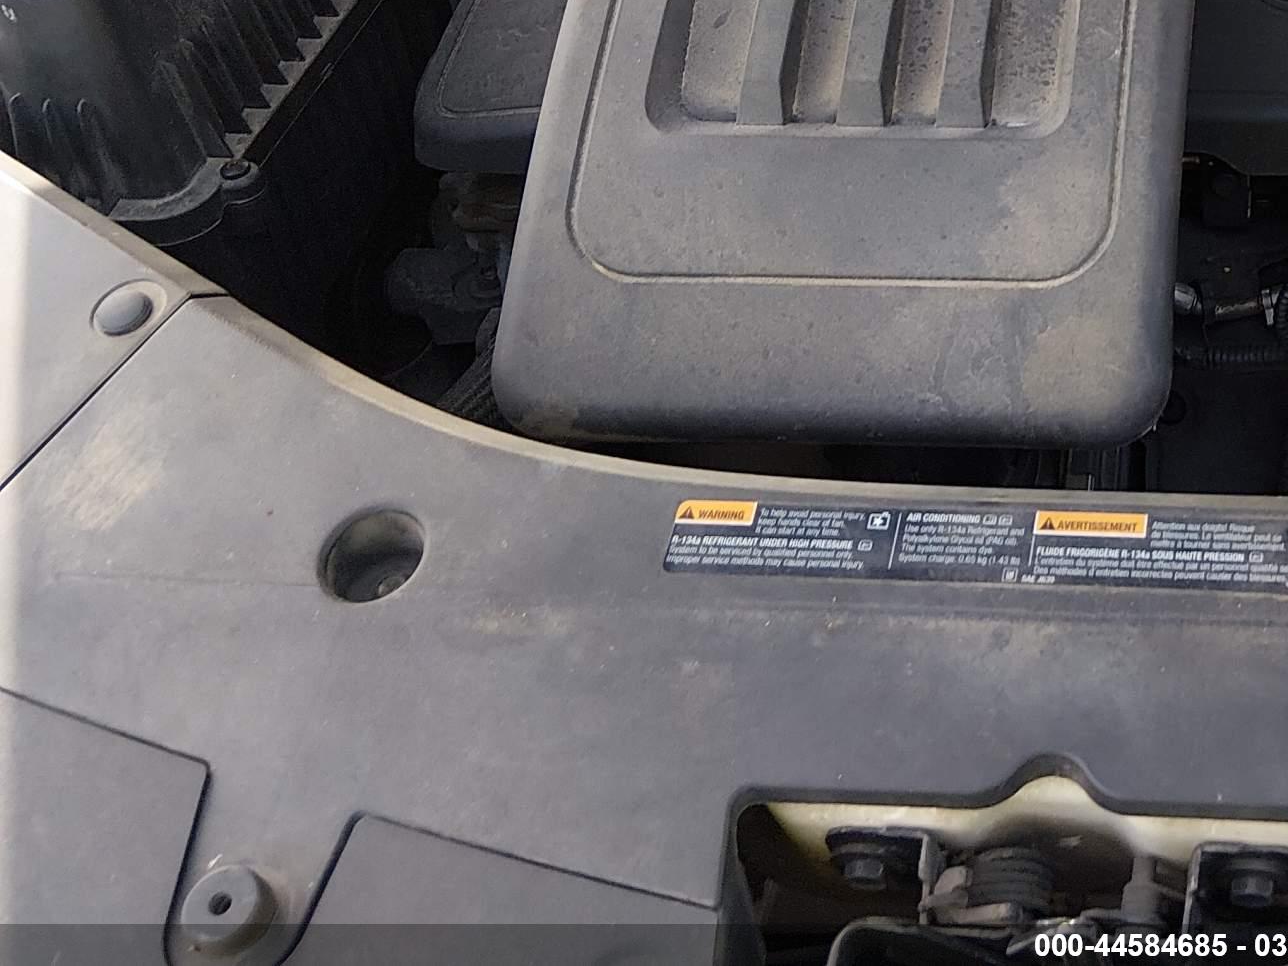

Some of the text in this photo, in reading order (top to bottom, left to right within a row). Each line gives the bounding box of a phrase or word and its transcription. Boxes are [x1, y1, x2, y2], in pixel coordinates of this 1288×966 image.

[698, 509, 744, 520] WARNING
[810, 510, 842, 519] personal
[906, 513, 981, 524] AIR CONDITIONING
[1057, 521, 1137, 533] AVERTISSEMENT
[703, 536, 759, 546] REFRIGERANT
[760, 537, 788, 547] UNDER
[789, 538, 809, 548] HIGH
[810, 539, 853, 550] PRESSURE
[719, 547, 752, 555] serviced
[1036, 546, 1065, 556] FLUIDE
[1152, 550, 1173, 560] SOUS
[1175, 551, 1202, 561] HAUTE
[1204, 552, 1244, 562] PRESSION
